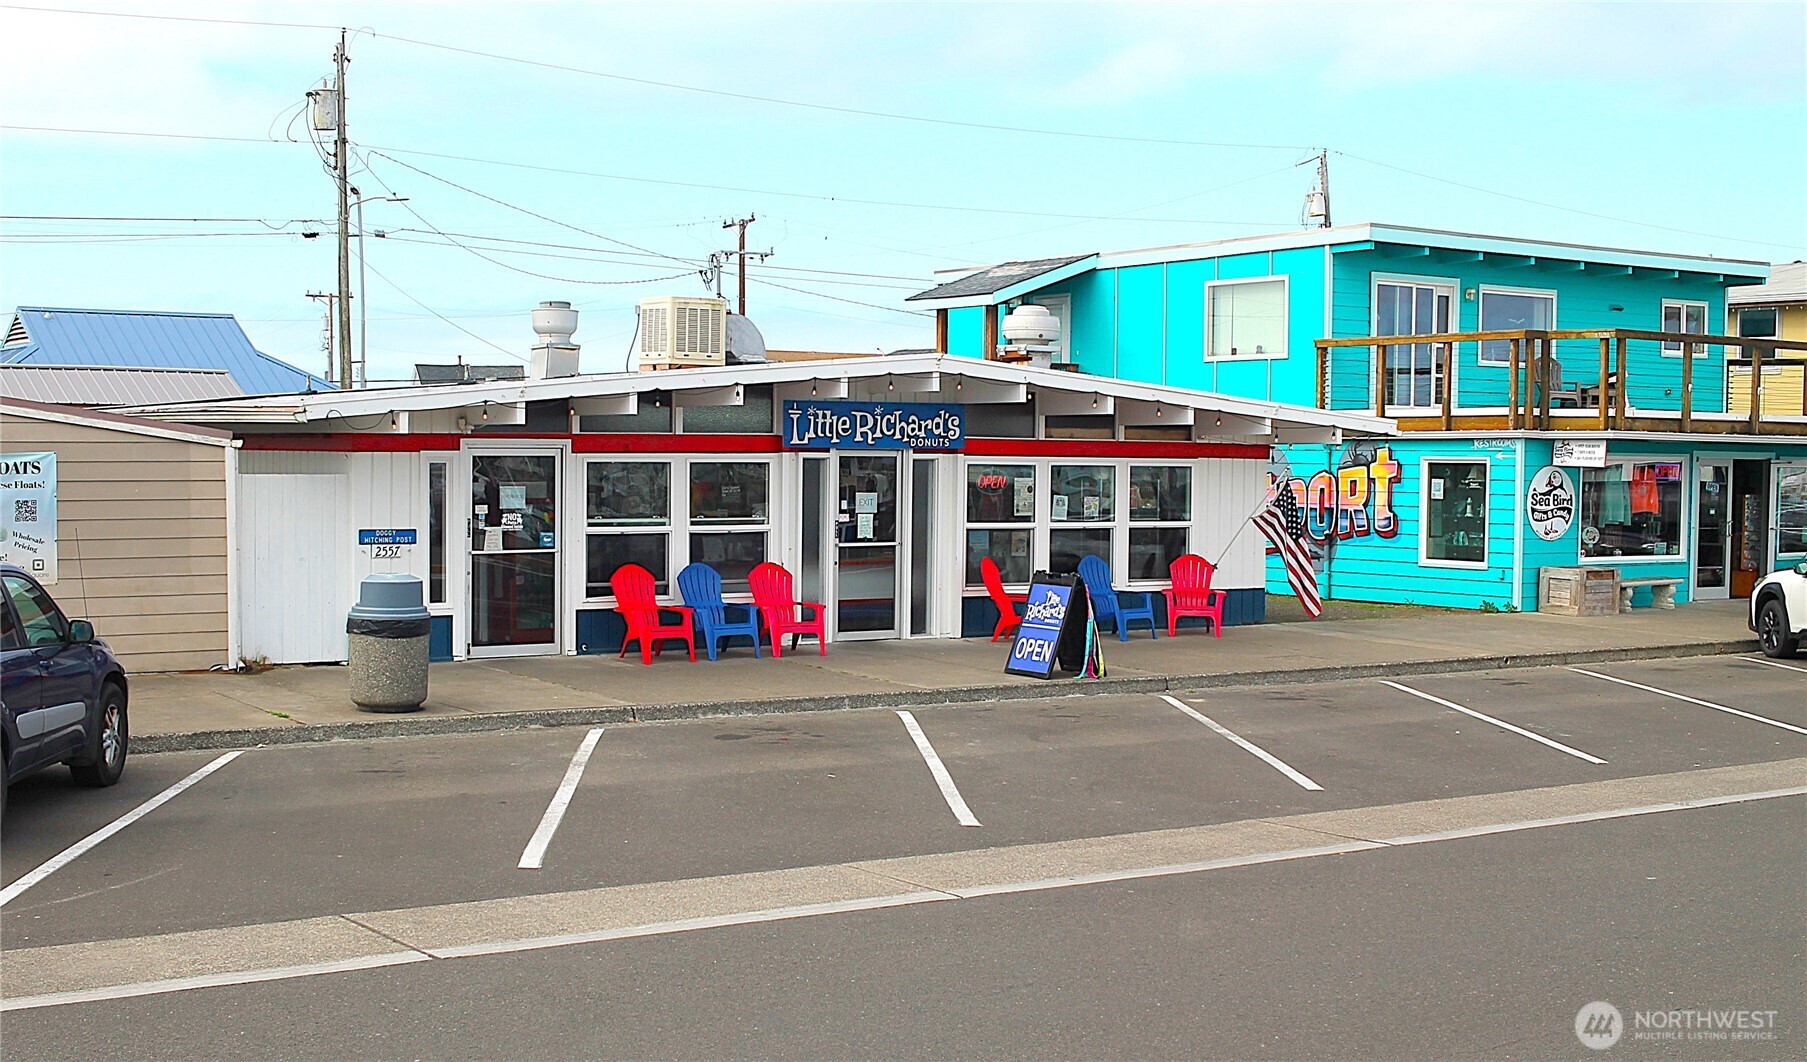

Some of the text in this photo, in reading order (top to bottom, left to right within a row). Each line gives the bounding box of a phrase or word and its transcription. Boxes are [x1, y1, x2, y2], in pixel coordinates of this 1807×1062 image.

[788, 402, 960, 445] Little Richard's
[910, 438, 950, 447] DONUTS
[1473, 438, 1517, 450] RESTROOMS
[1657, 466, 1679, 477] OPEN
[14, 481, 45, 489] Floats!
[977, 475, 1007, 489] OPEN
[858, 498, 874, 506] EXIT
[1531, 493, 1573, 507] Sea Bird
[1533, 508, 1570, 521] Gifts & Candy
[12, 530, 46, 545] Wholesale
[364, 536, 393, 544] HITCHING
[13, 541, 39, 554] Pricing
[375, 546, 401, 557] 2557
[1025, 601, 1065, 621] Richard's
[1015, 637, 1054, 663] OPEN
